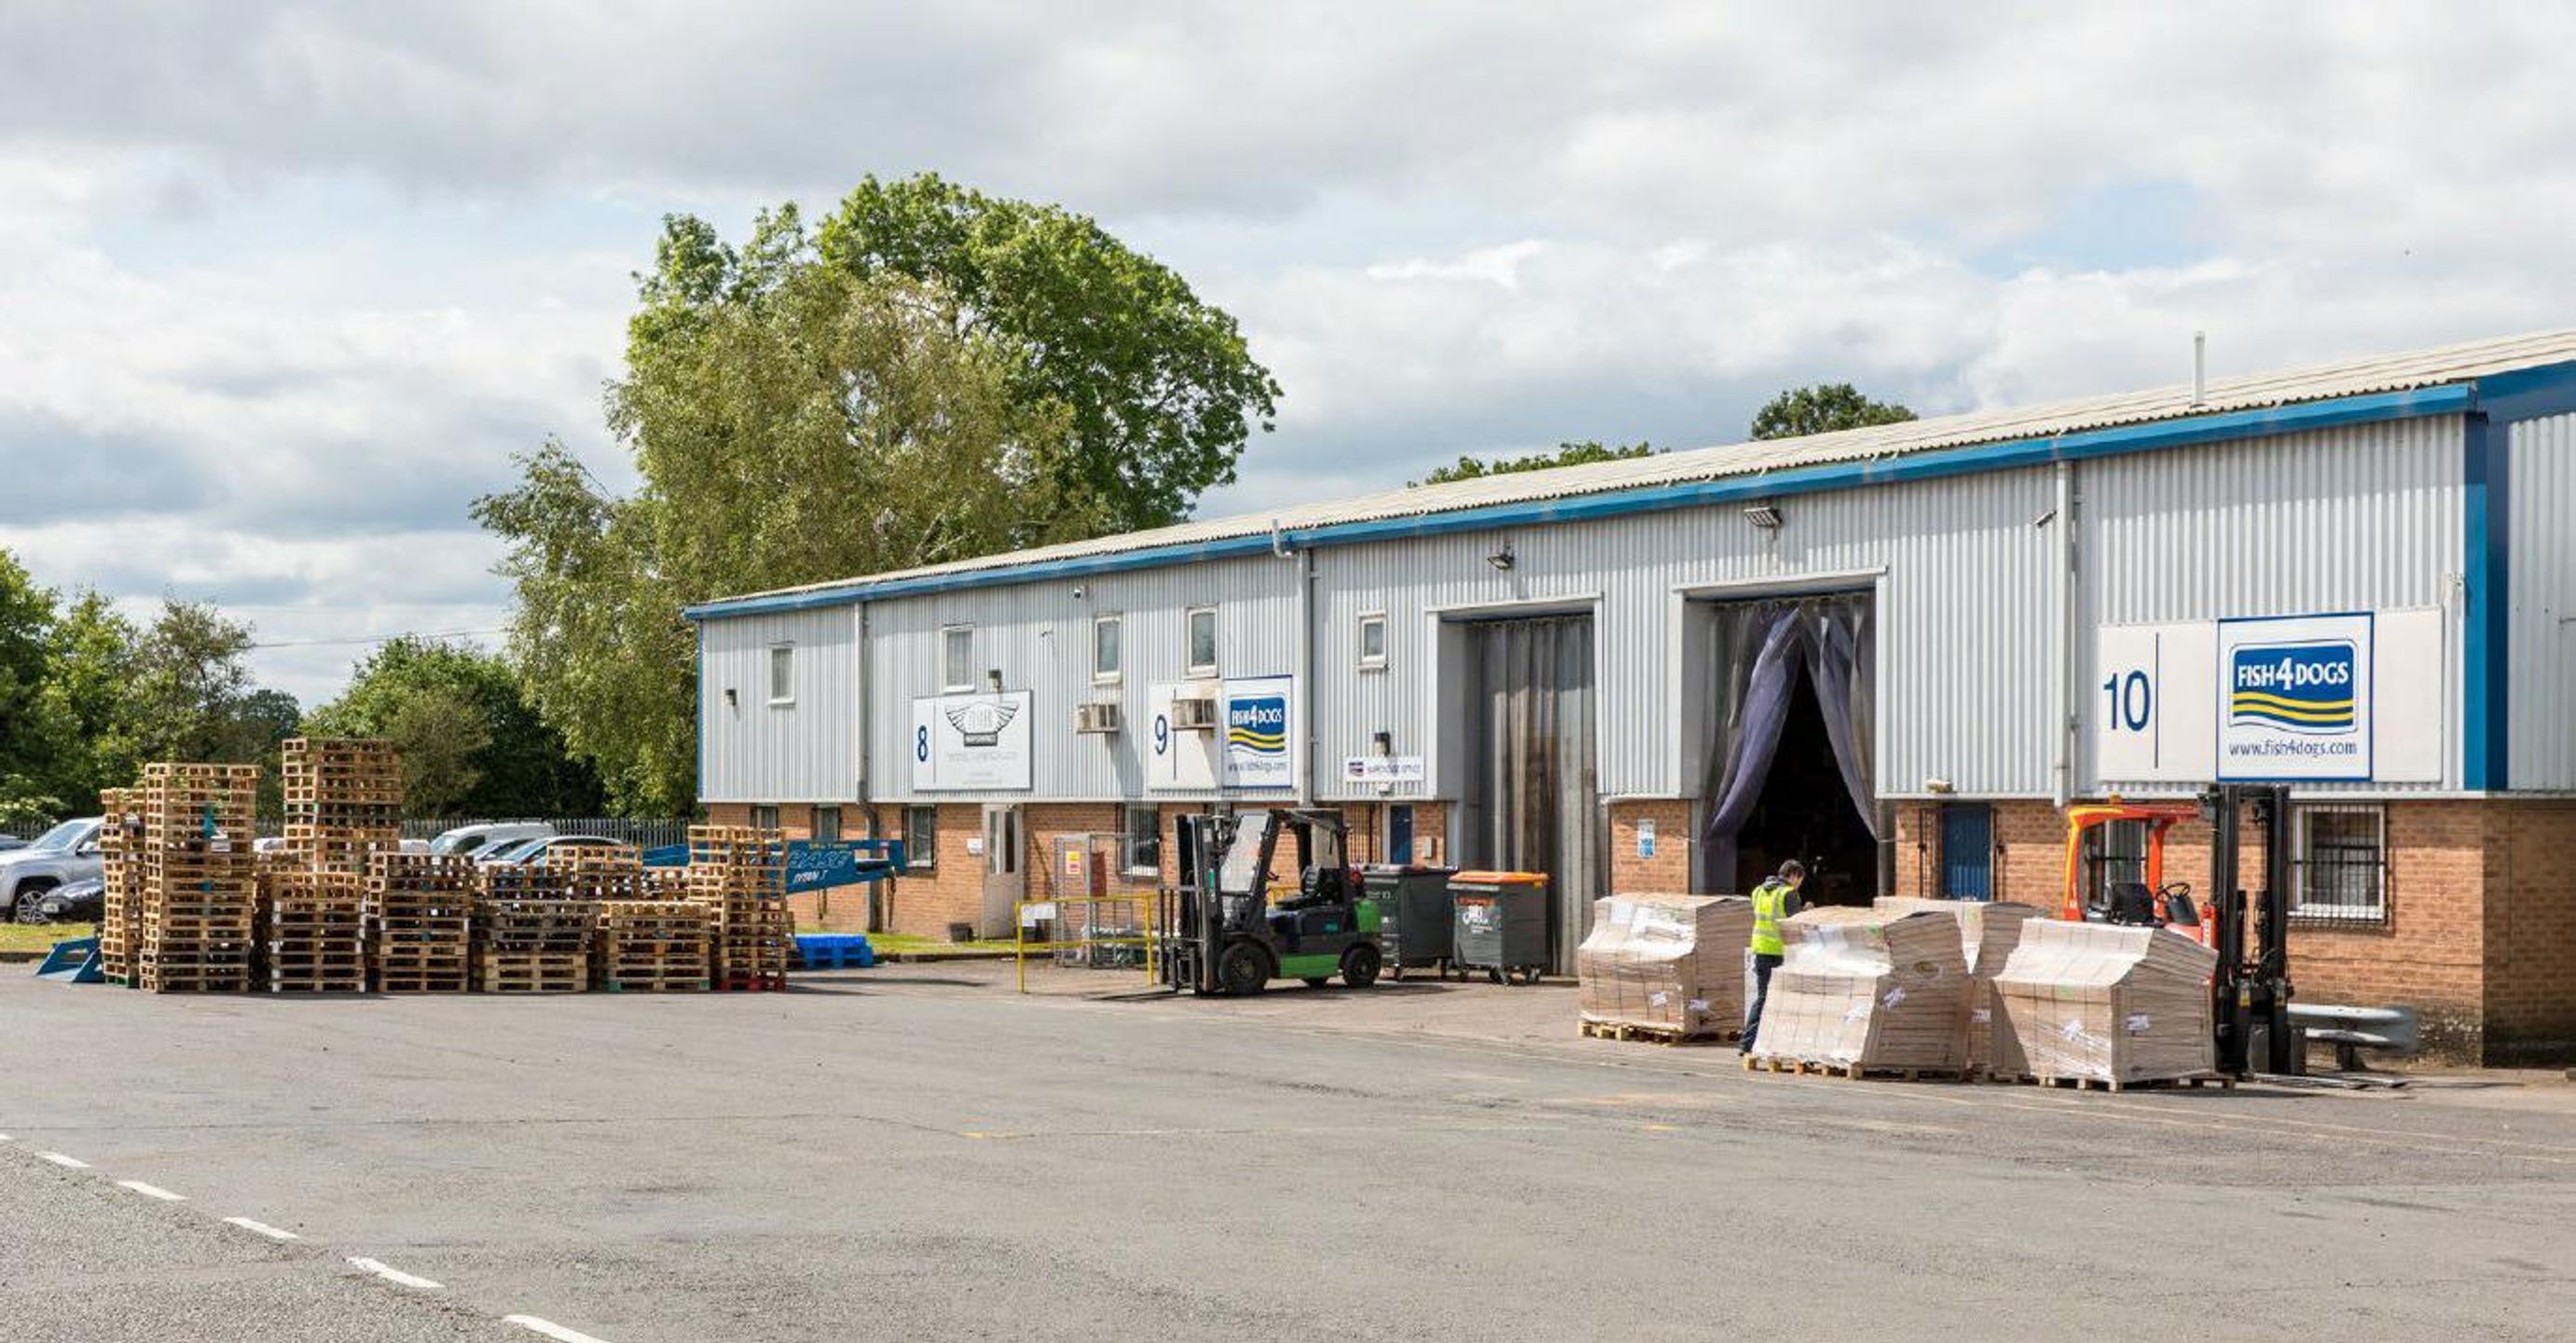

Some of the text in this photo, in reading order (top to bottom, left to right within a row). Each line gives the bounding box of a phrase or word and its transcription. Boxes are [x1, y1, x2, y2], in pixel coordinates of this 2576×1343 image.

[2238, 658, 2349, 691] FISH4DOGS
[1232, 705, 1282, 727] FISH4DOGS
[2103, 671, 2150, 731] 10
[917, 725, 929, 762] 8
[1154, 714, 1167, 755] 9
[2229, 739, 2358, 757] www.fish4dogs.com
